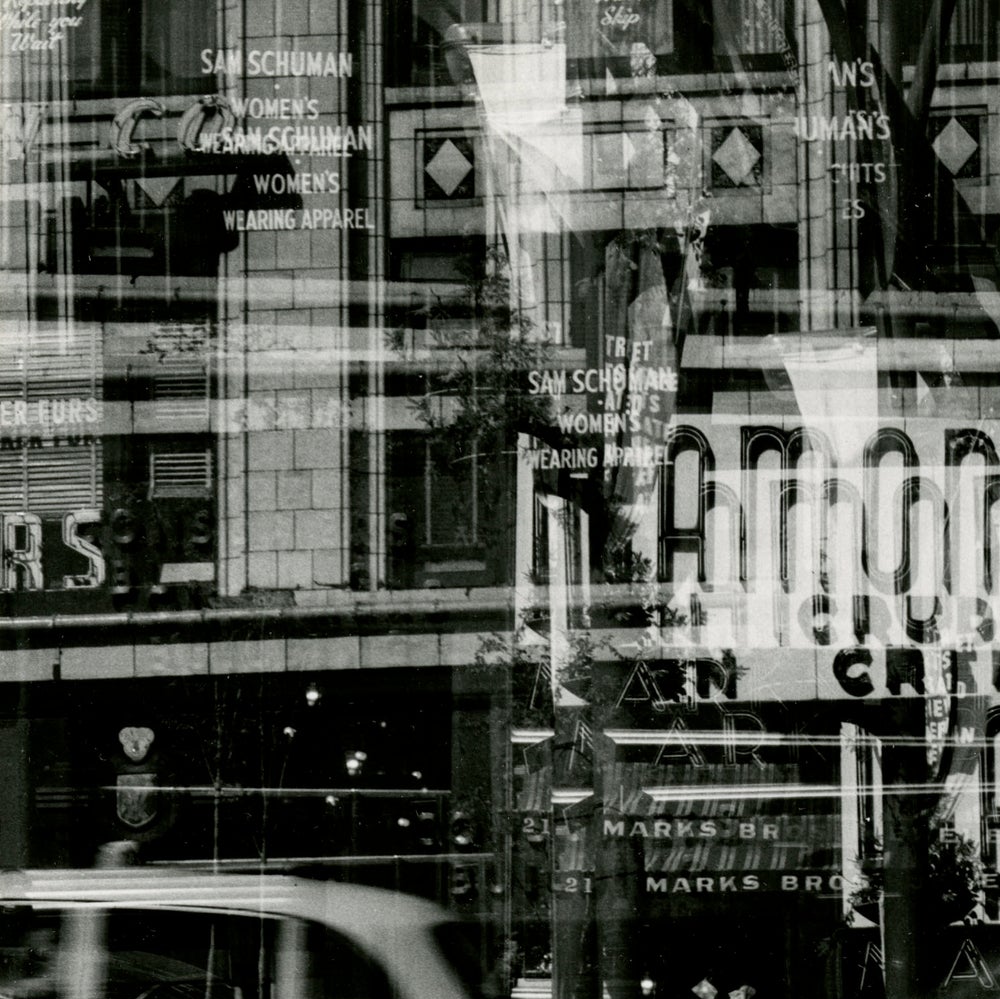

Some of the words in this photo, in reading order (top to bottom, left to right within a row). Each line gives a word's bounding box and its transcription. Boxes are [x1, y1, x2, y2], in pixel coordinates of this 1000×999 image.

[201, 49, 241, 75] SAM
[248, 51, 353, 78] SCHUMAN
[231, 97, 319, 121] WOMEN'S
[253, 169, 340, 195] WOMEN'S
[223, 209, 296, 231] WEARING
[301, 208, 375, 230] APPAREL
[528, 371, 566, 395] SAM
[528, 446, 597, 469] WEARING
[603, 818, 717, 839] MARKS
[646, 875, 759, 893] MARKS
